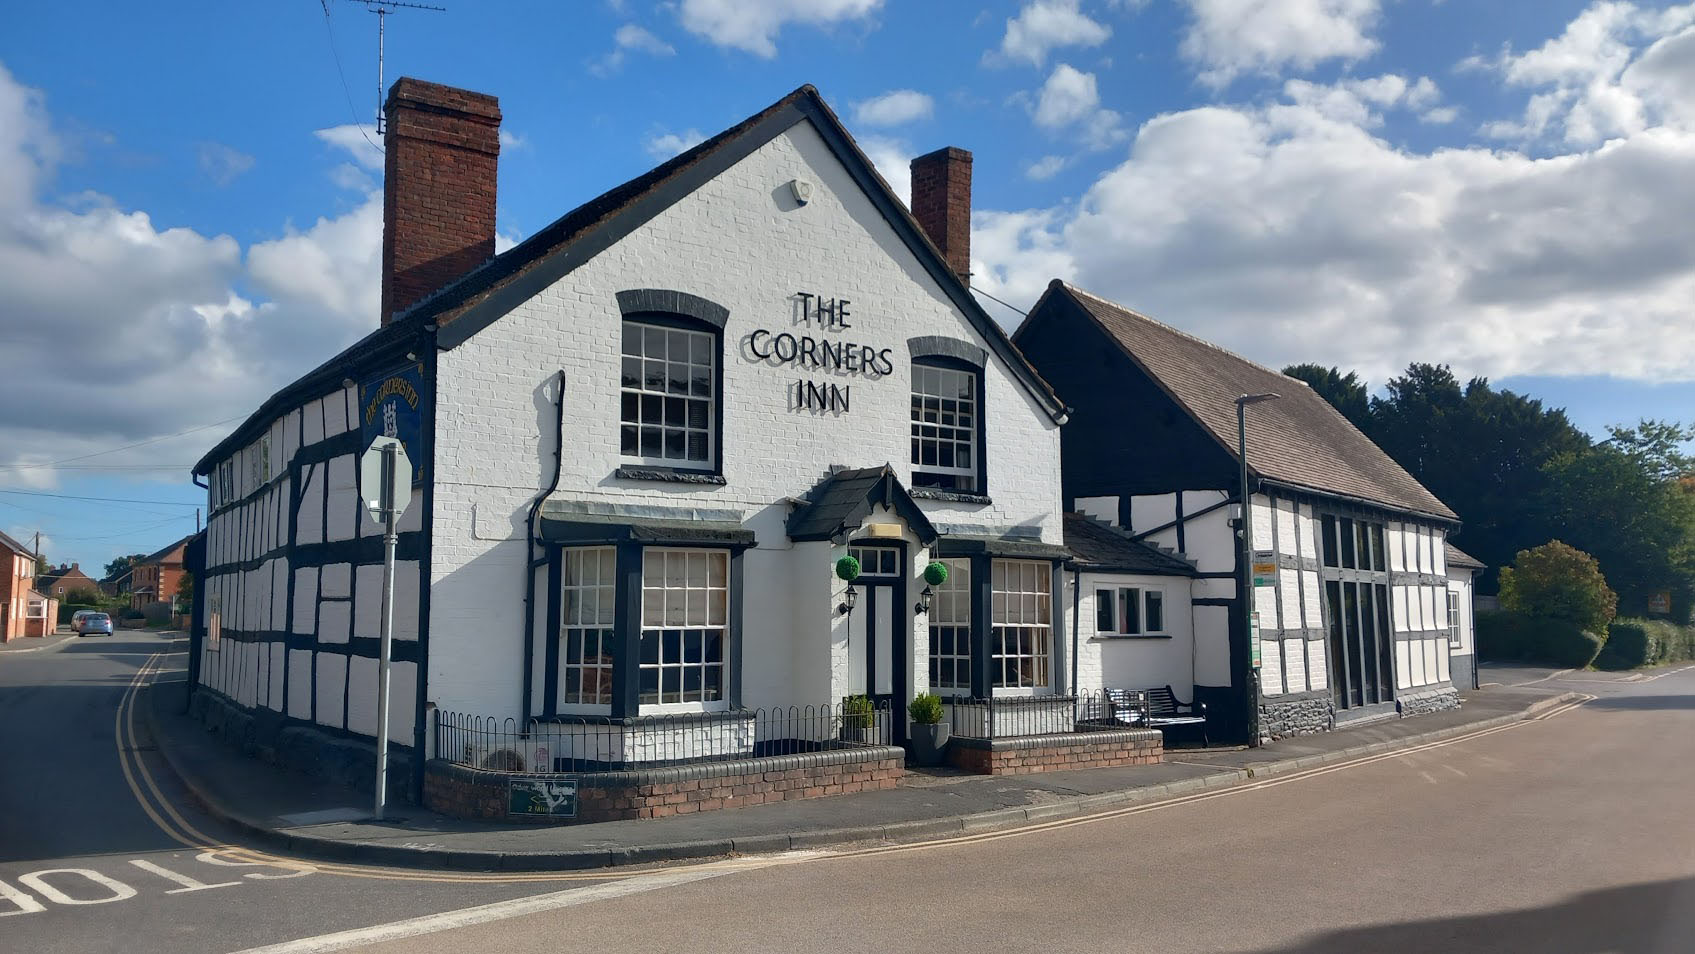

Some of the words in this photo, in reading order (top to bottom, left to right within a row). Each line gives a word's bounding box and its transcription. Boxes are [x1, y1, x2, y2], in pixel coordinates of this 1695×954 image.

[797, 291, 851, 328] THE
[750, 329, 893, 375] CORNERS
[799, 379, 850, 412] INN
